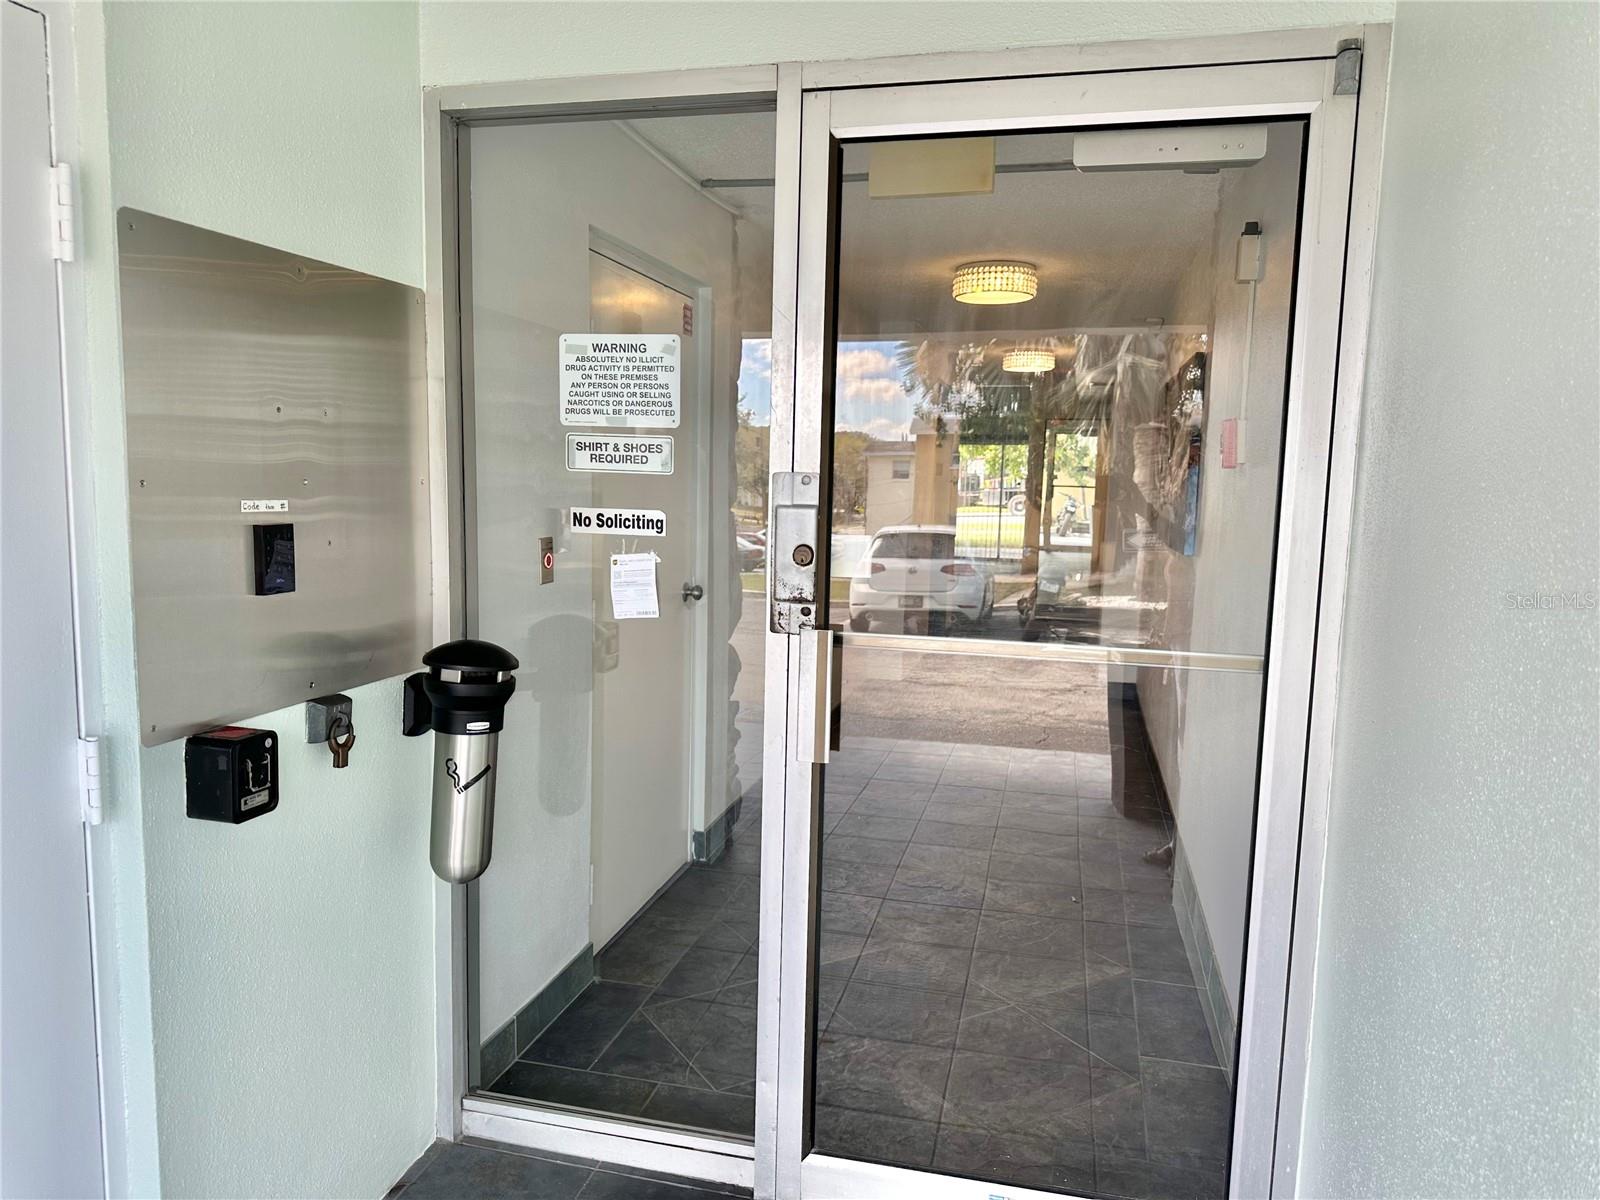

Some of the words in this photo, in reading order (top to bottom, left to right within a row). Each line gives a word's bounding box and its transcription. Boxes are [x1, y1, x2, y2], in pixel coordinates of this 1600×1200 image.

[592, 344, 647, 353] WARNING
[576, 442, 609, 452] SHIRT
[612, 443, 620, 452] &
[624, 443, 663, 453] SHOES
[590, 454, 648, 464] REQUIRED
[572, 512, 591, 527] No
[596, 513, 663, 534] Soliciting
